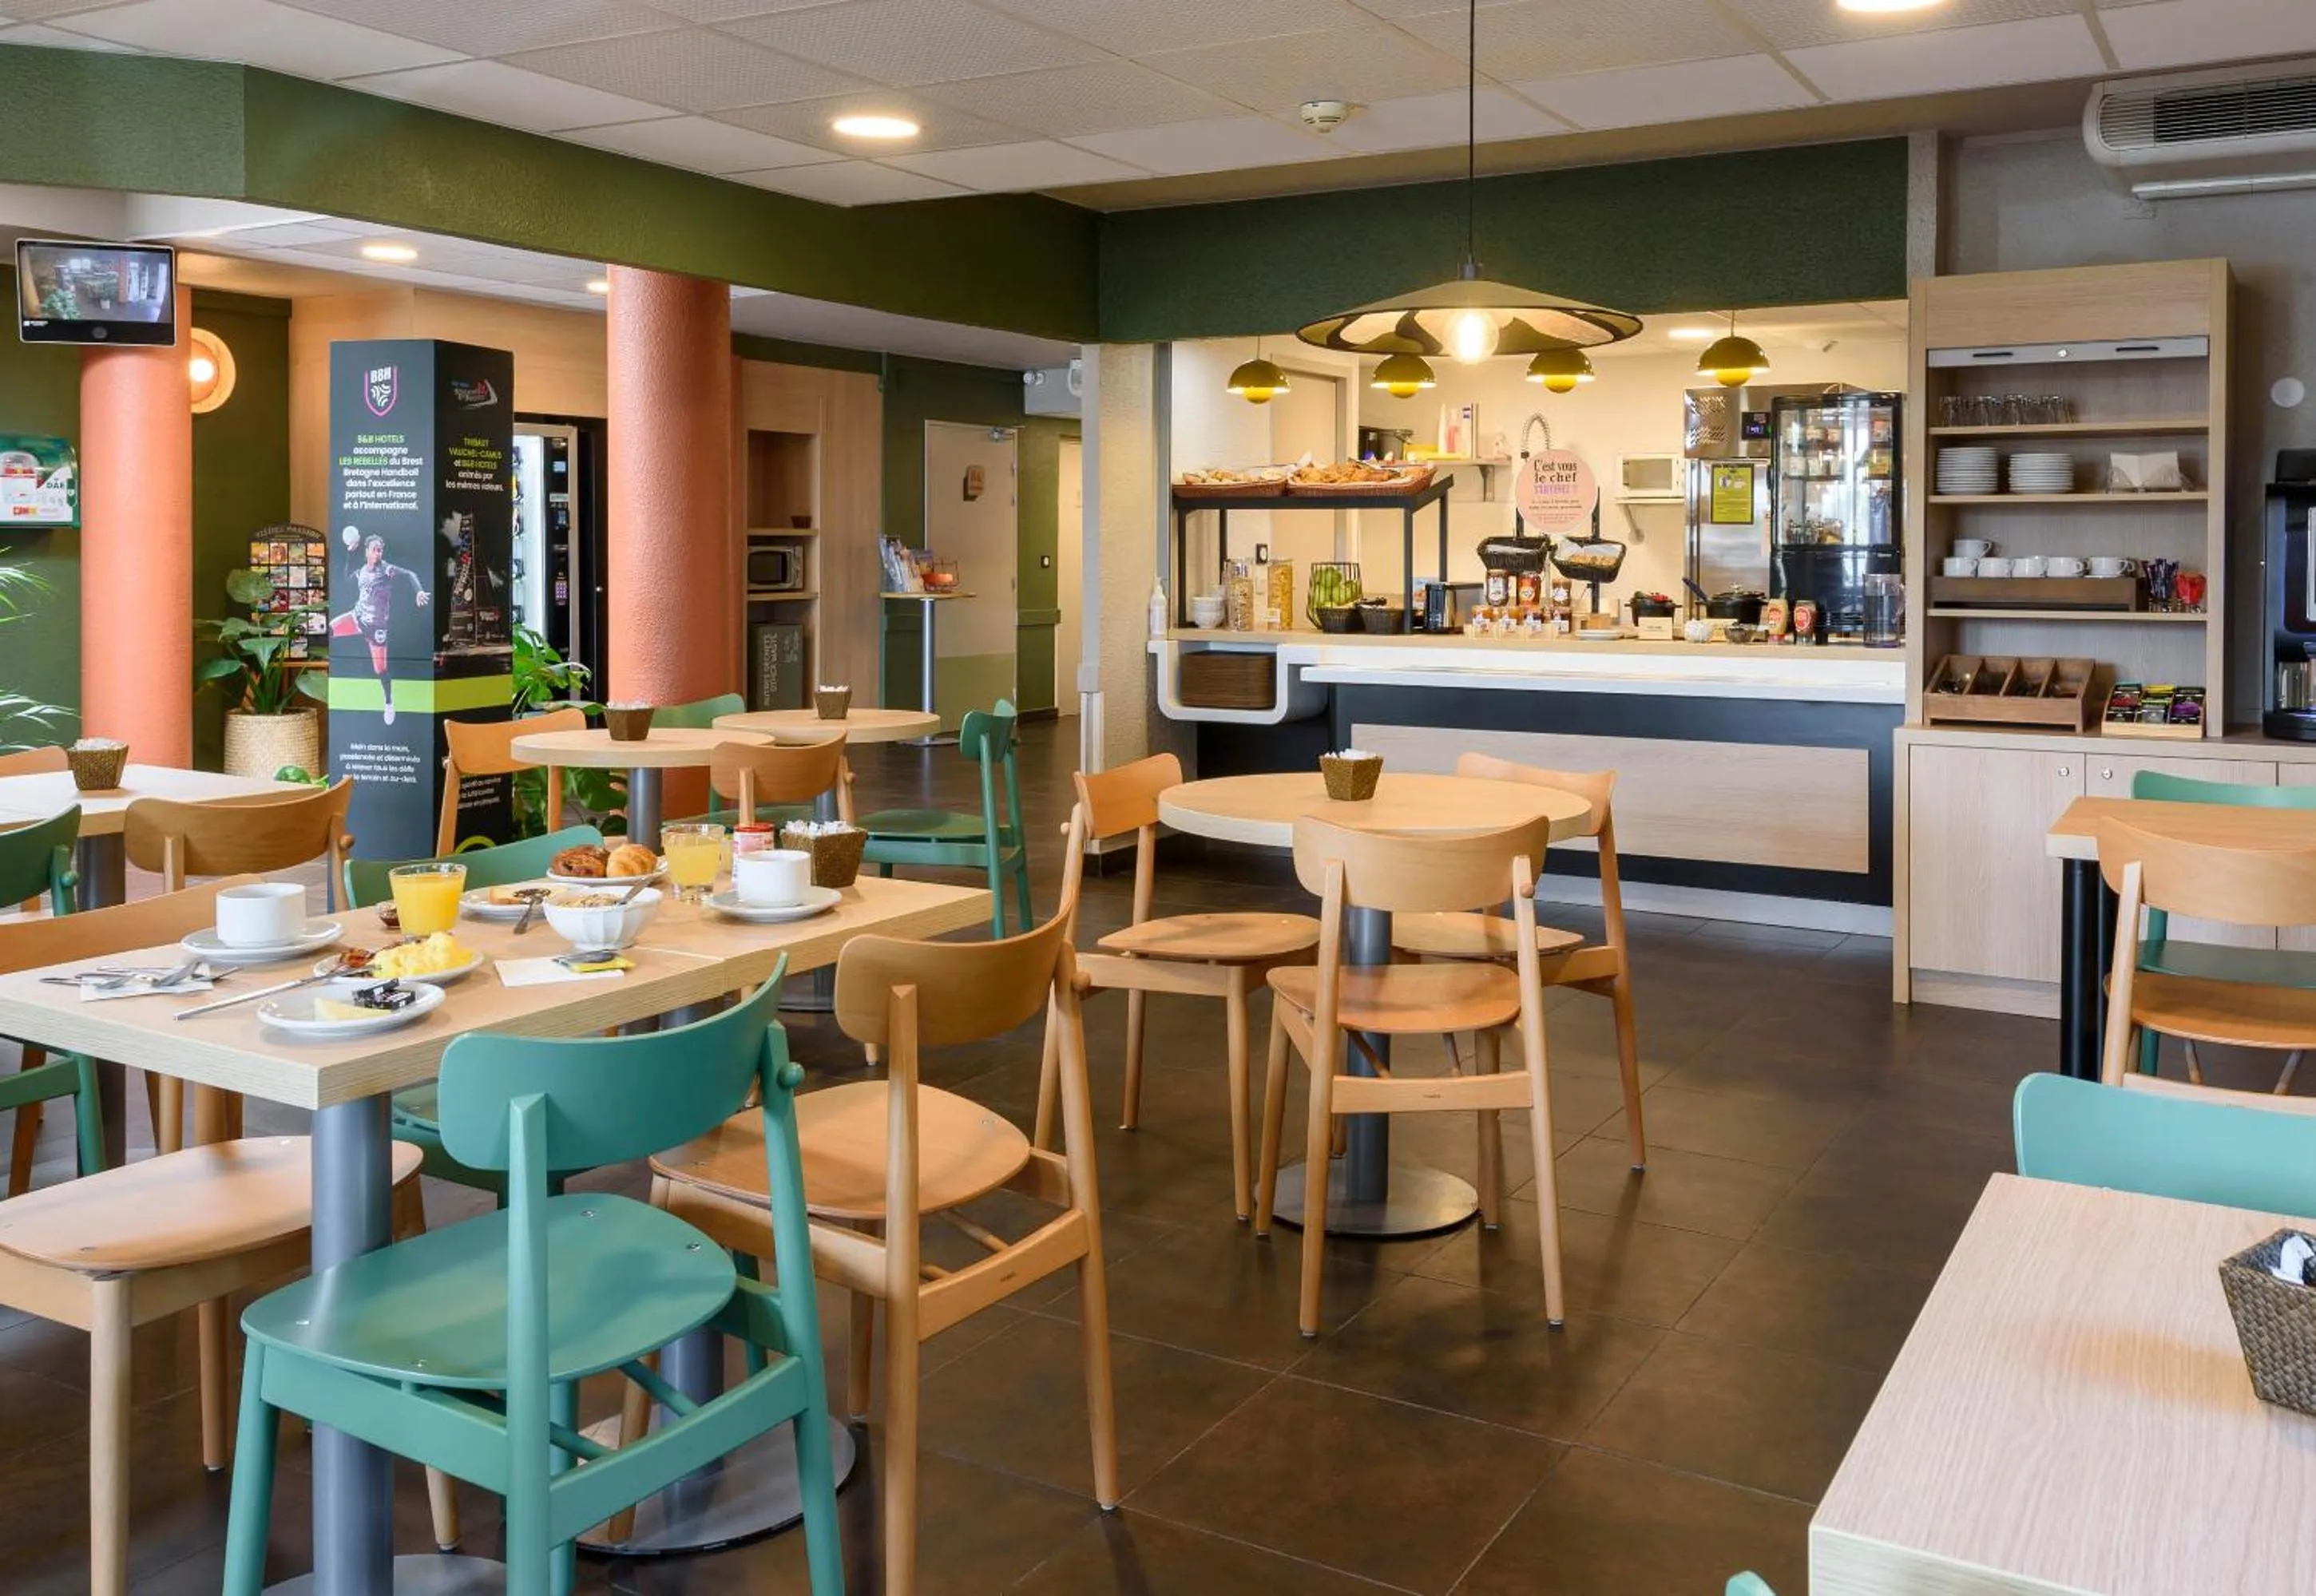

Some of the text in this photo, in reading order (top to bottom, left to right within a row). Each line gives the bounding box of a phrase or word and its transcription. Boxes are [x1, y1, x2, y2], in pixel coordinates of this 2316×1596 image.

[370, 366, 391, 383] BBH
[375, 434, 406, 444] HOTELS
[353, 446, 408, 457] accompagne
[389, 457, 400, 465] du
[401, 457, 423, 465] Brest
[343, 468, 419, 479] Bretagne Handball
[1533, 472, 1577, 483] le chef
[345, 490, 375, 501] partout
[388, 490, 418, 499] France
